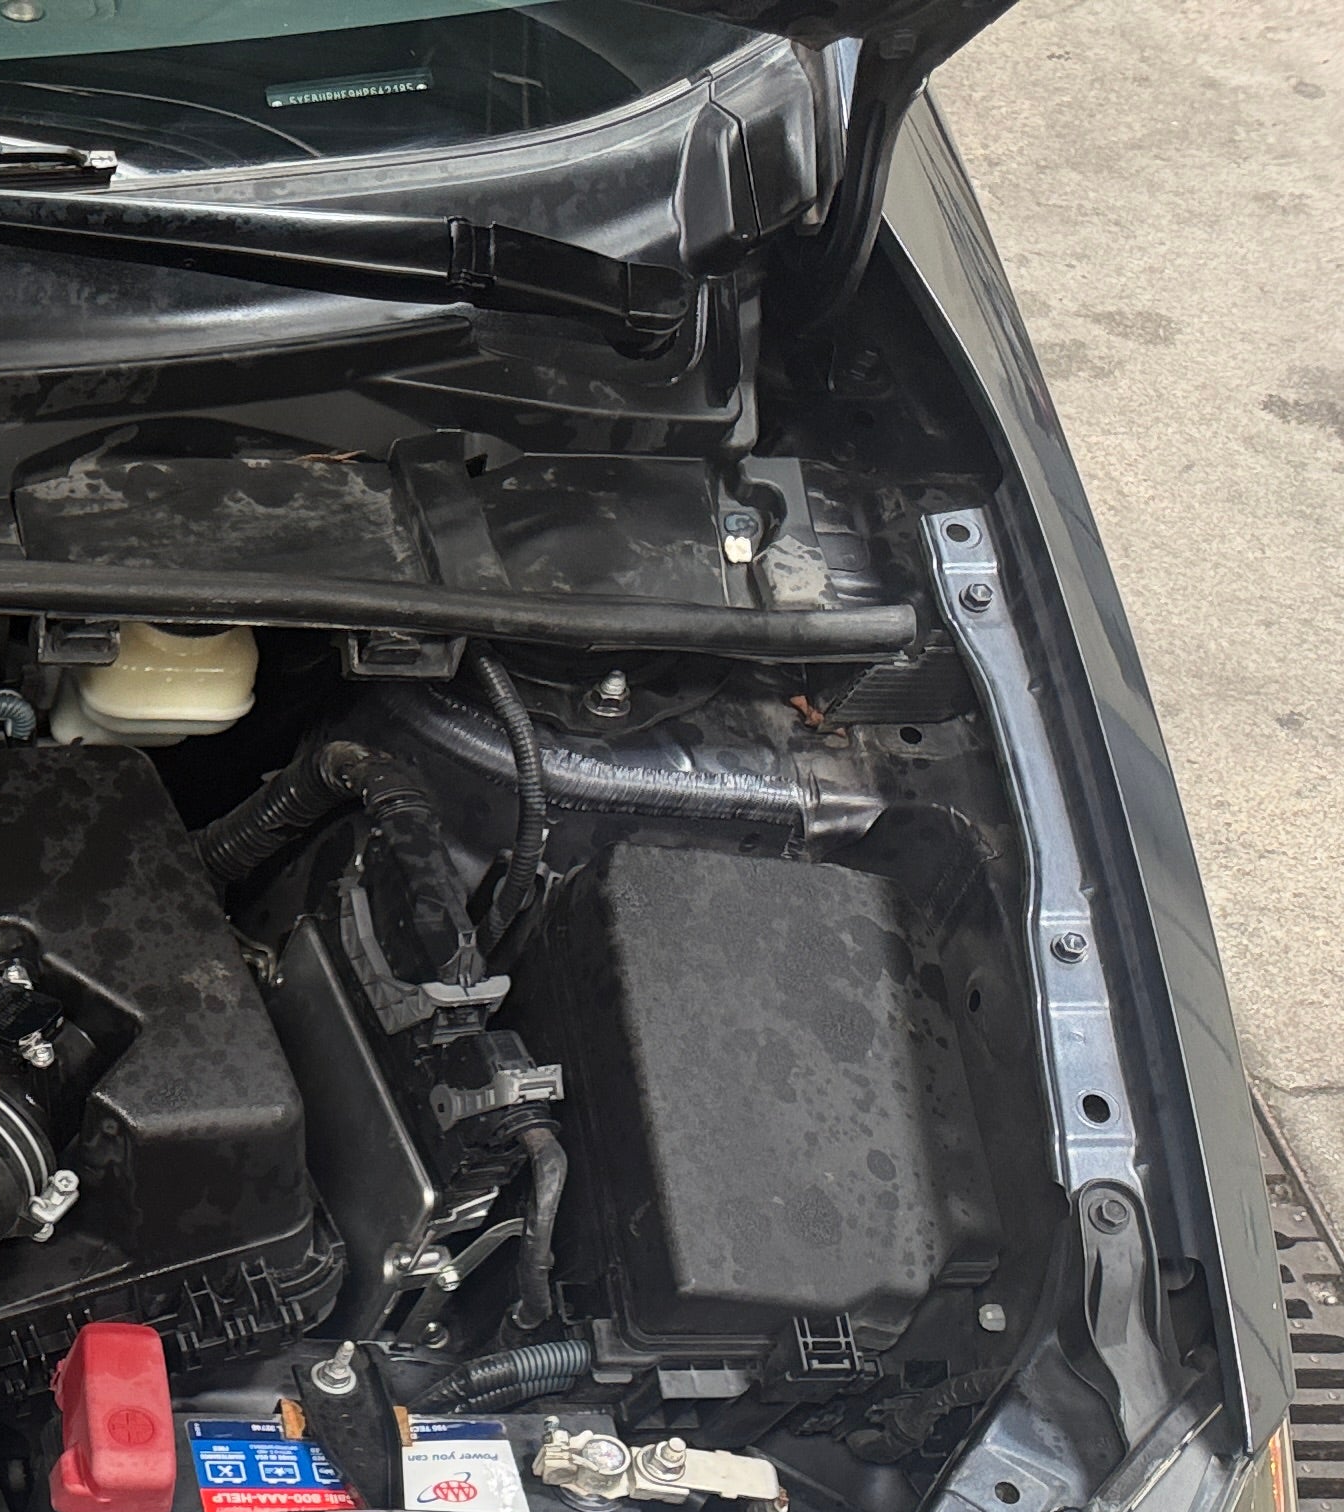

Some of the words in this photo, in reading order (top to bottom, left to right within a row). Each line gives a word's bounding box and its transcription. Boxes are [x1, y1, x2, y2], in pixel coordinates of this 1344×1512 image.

[407, 1454, 428, 1462] can
[432, 1451, 456, 1461] you
[461, 1453, 498, 1462] Power
[212, 1492, 321, 1504] 800-AAA-HELP
